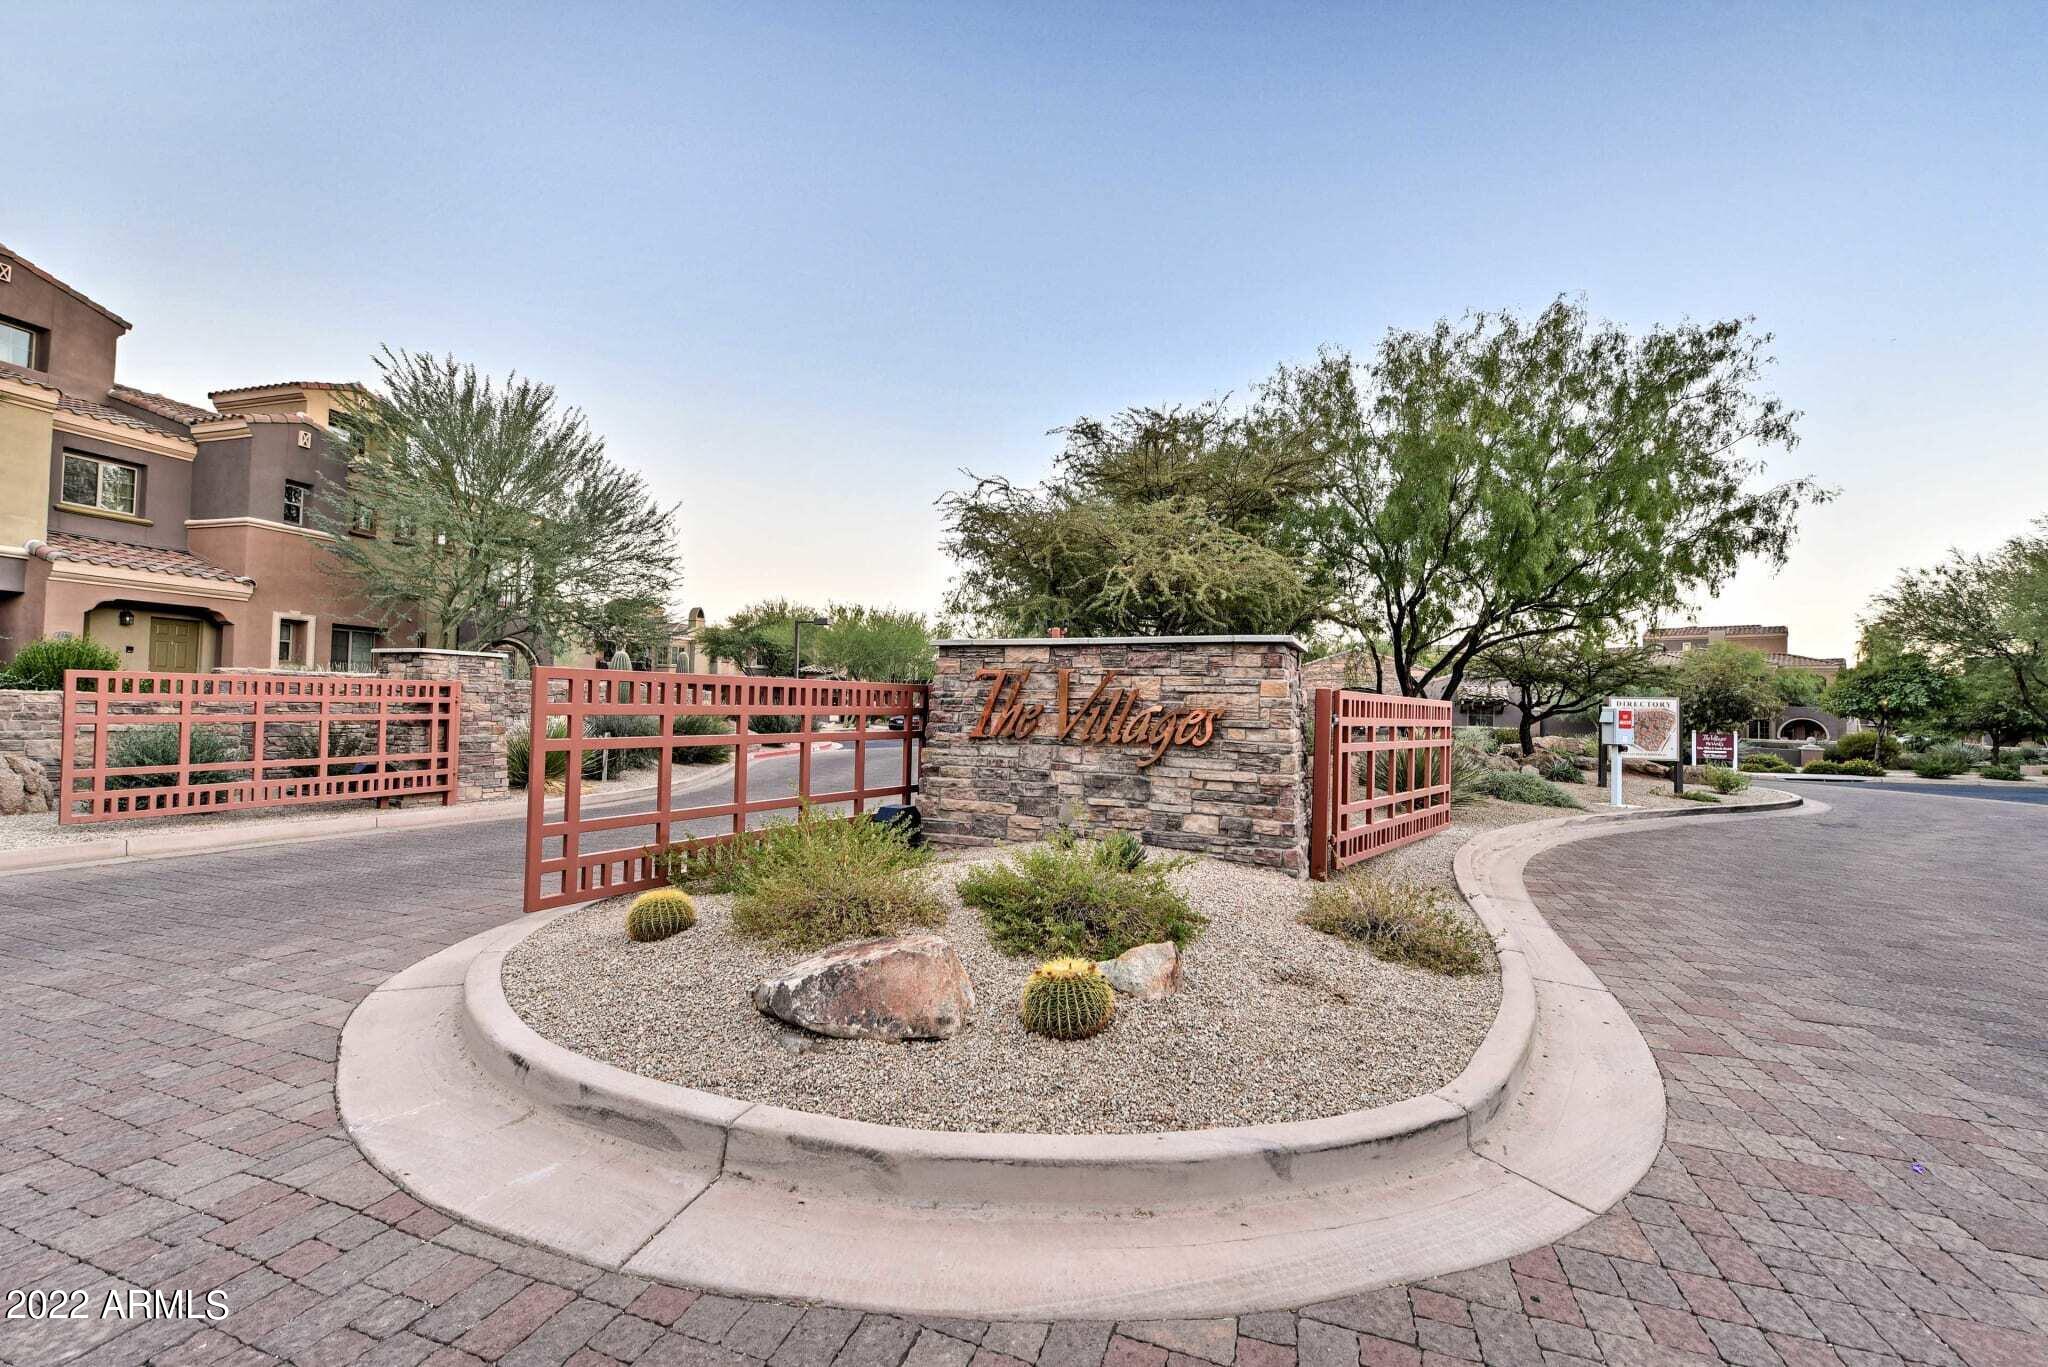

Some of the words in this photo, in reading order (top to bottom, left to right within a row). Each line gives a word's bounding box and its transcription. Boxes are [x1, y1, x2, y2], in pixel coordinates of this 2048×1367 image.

[967, 668, 1044, 739] The
[1056, 668, 1224, 768] Villages
[1616, 700, 1671, 708] DIRECTORY
